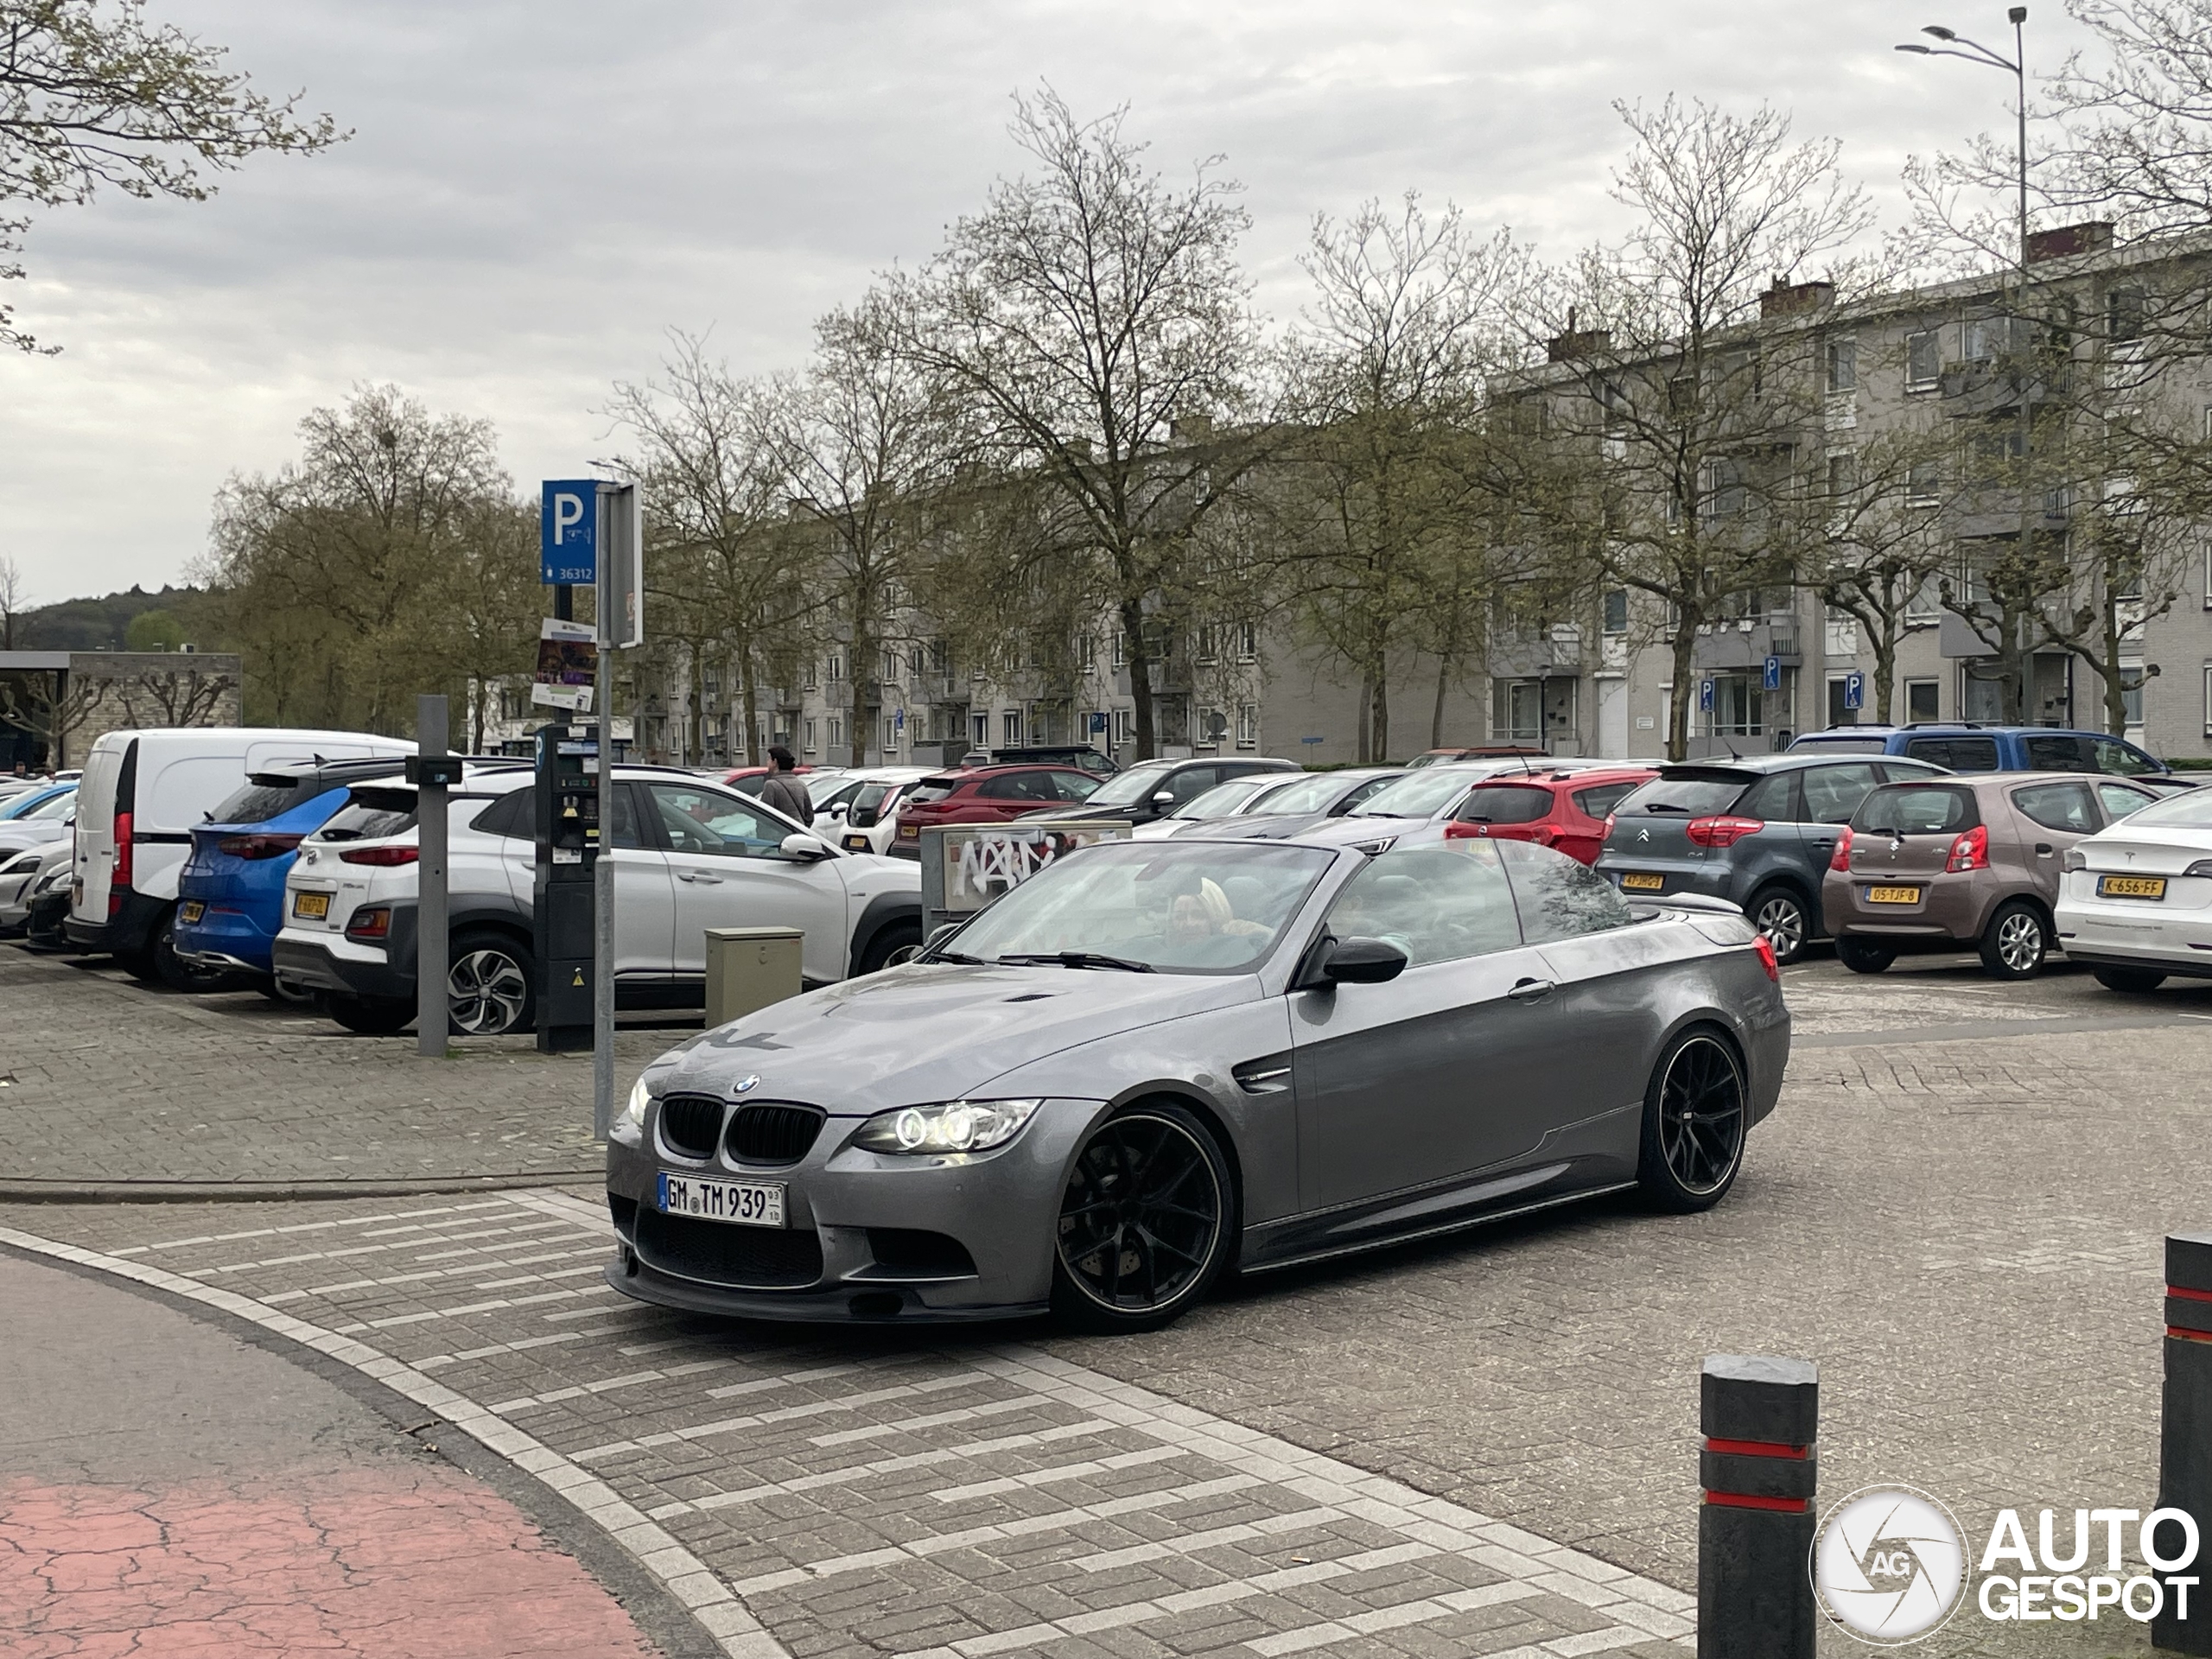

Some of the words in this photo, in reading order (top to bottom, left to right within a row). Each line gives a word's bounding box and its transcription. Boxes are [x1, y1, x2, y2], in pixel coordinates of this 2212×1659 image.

[555, 493, 584, 545] P
[559, 568, 593, 580] 36312
[1767, 658, 1777, 677] P
[1702, 682, 1713, 699] P
[1849, 677, 1860, 695] P
[536, 735, 543, 766] P
[1873, 888, 1915, 901] 05-TJF-8
[2105, 880, 2158, 893] K-656-FF
[668, 1179, 688, 1211] GM
[700, 1184, 723, 1215] TM
[729, 1187, 766, 1219] 939
